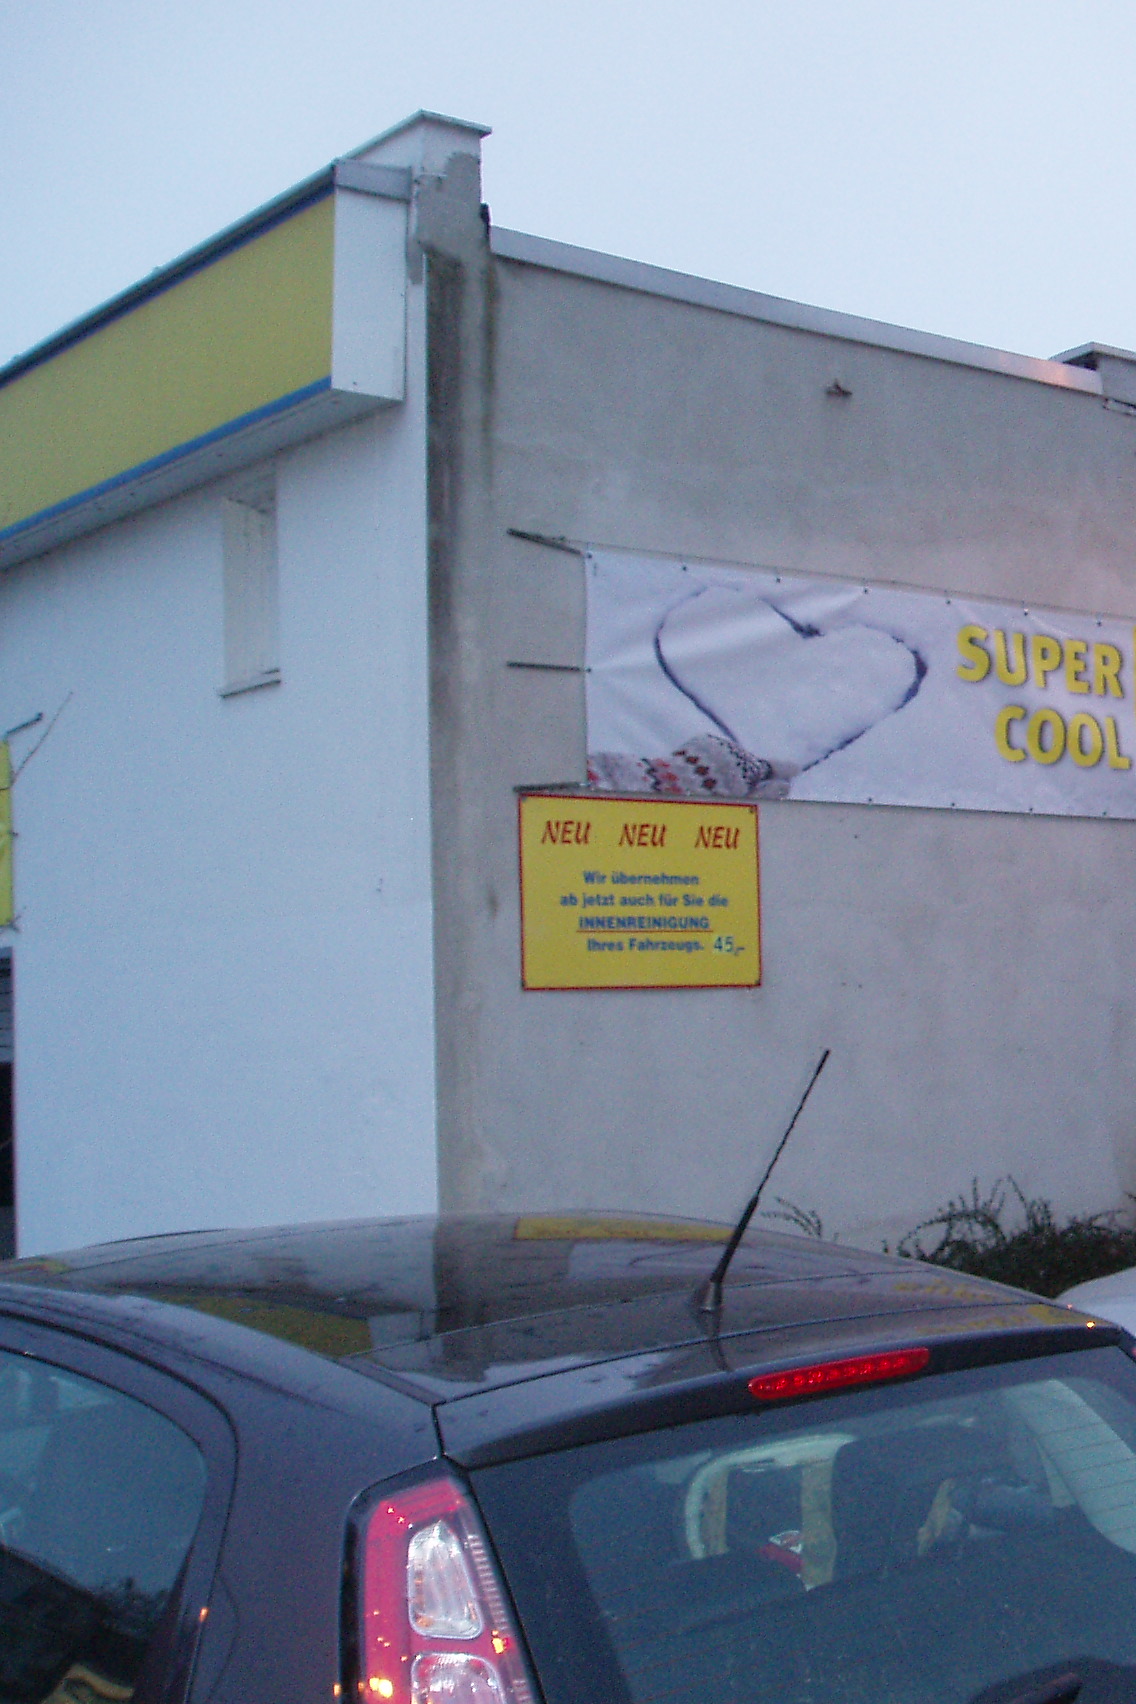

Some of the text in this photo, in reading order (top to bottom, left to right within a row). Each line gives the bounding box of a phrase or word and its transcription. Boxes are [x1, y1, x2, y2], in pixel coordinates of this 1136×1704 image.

[957, 624, 1124, 698] SUPER
[994, 705, 1132, 770] COOL
[541, 820, 740, 849] NEU NEU NEU
[583, 871, 699, 885] Wir übernehmen
[560, 893, 728, 908] ab jetzt auch für Sie die
[579, 916, 709, 929] INNENREINIGUNG
[587, 939, 623, 951] Ihres
